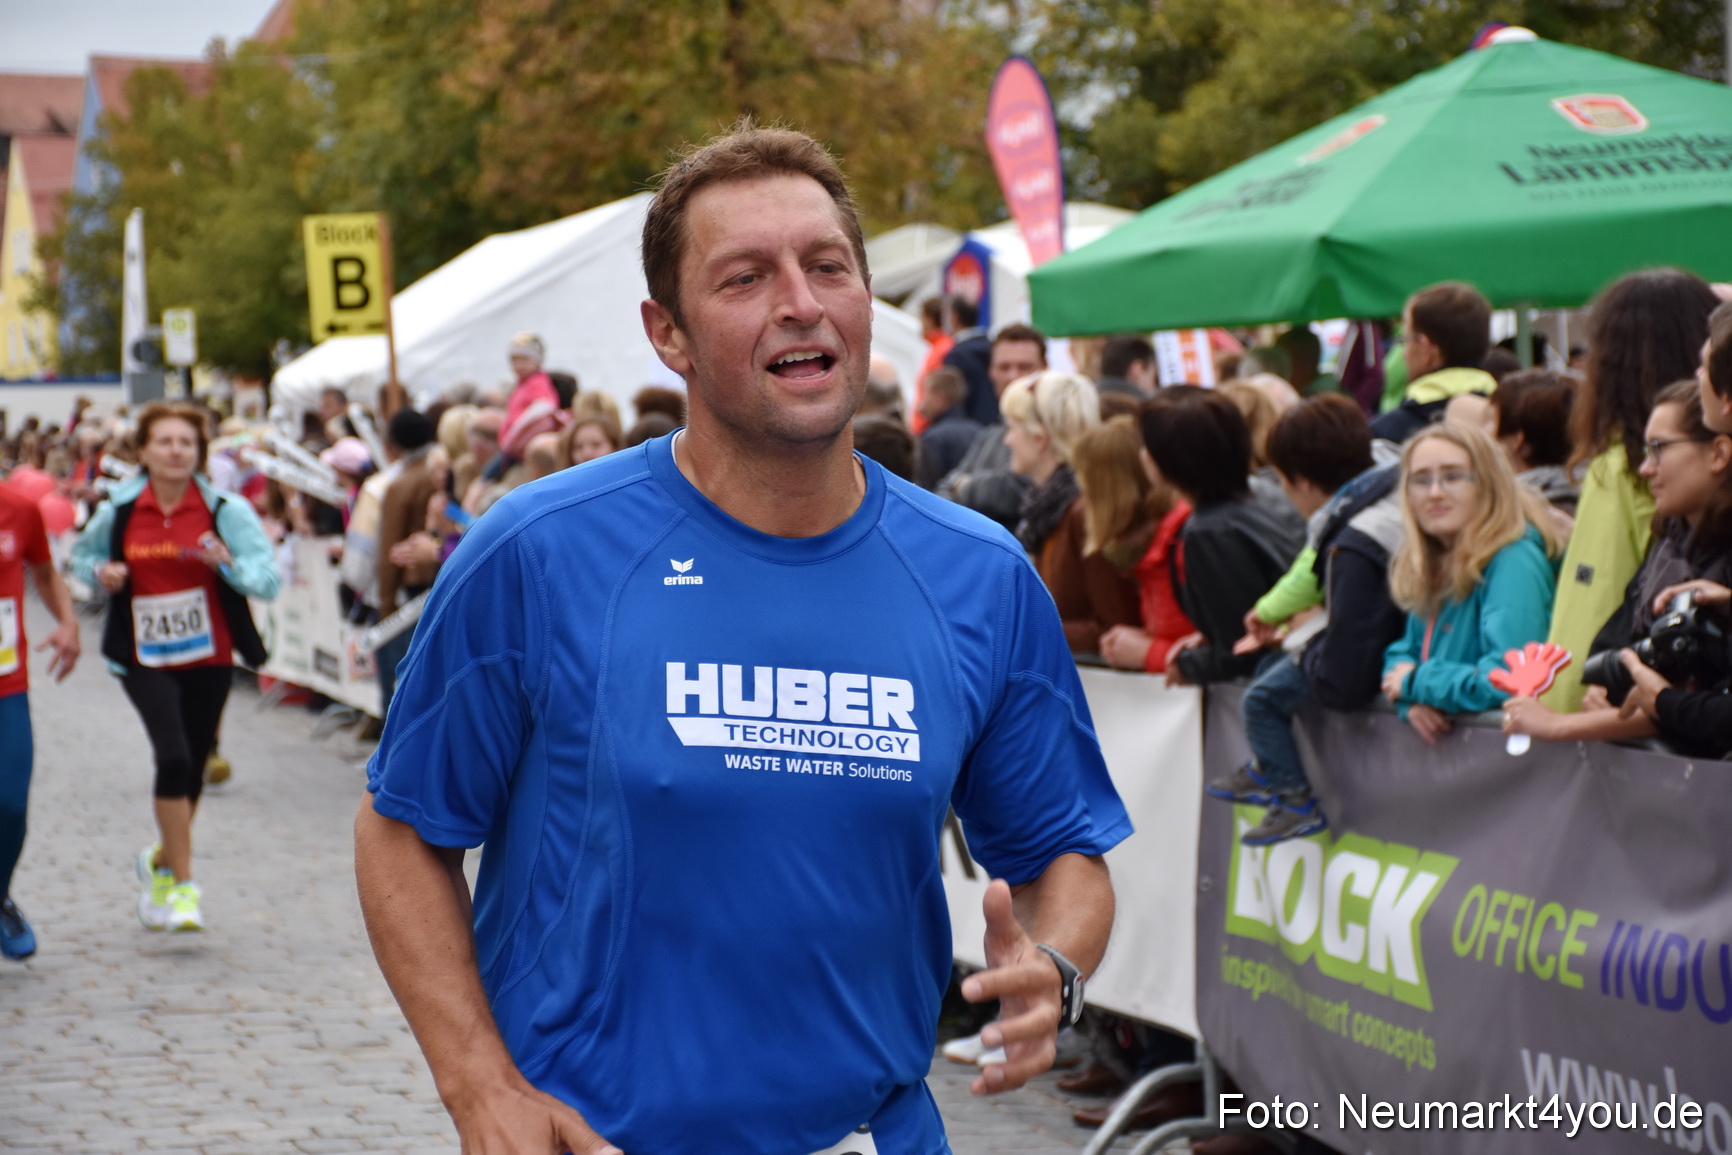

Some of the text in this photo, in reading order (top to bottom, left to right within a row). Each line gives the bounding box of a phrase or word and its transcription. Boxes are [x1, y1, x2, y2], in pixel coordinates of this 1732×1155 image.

[1498, 150, 1732, 185] Lammsb
[315, 223, 378, 246] Block
[333, 256, 370, 309] B
[664, 574, 703, 586] erima
[142, 608, 202, 641] 2450
[666, 662, 918, 731] HUBER
[723, 723, 911, 754] TECHNOLOGY
[724, 754, 913, 782] WASTE WATER Solutions
[1233, 817, 1441, 986] BOCK
[1452, 883, 1599, 990] OFFICE
[1352, 1011, 1437, 1073] concepts
